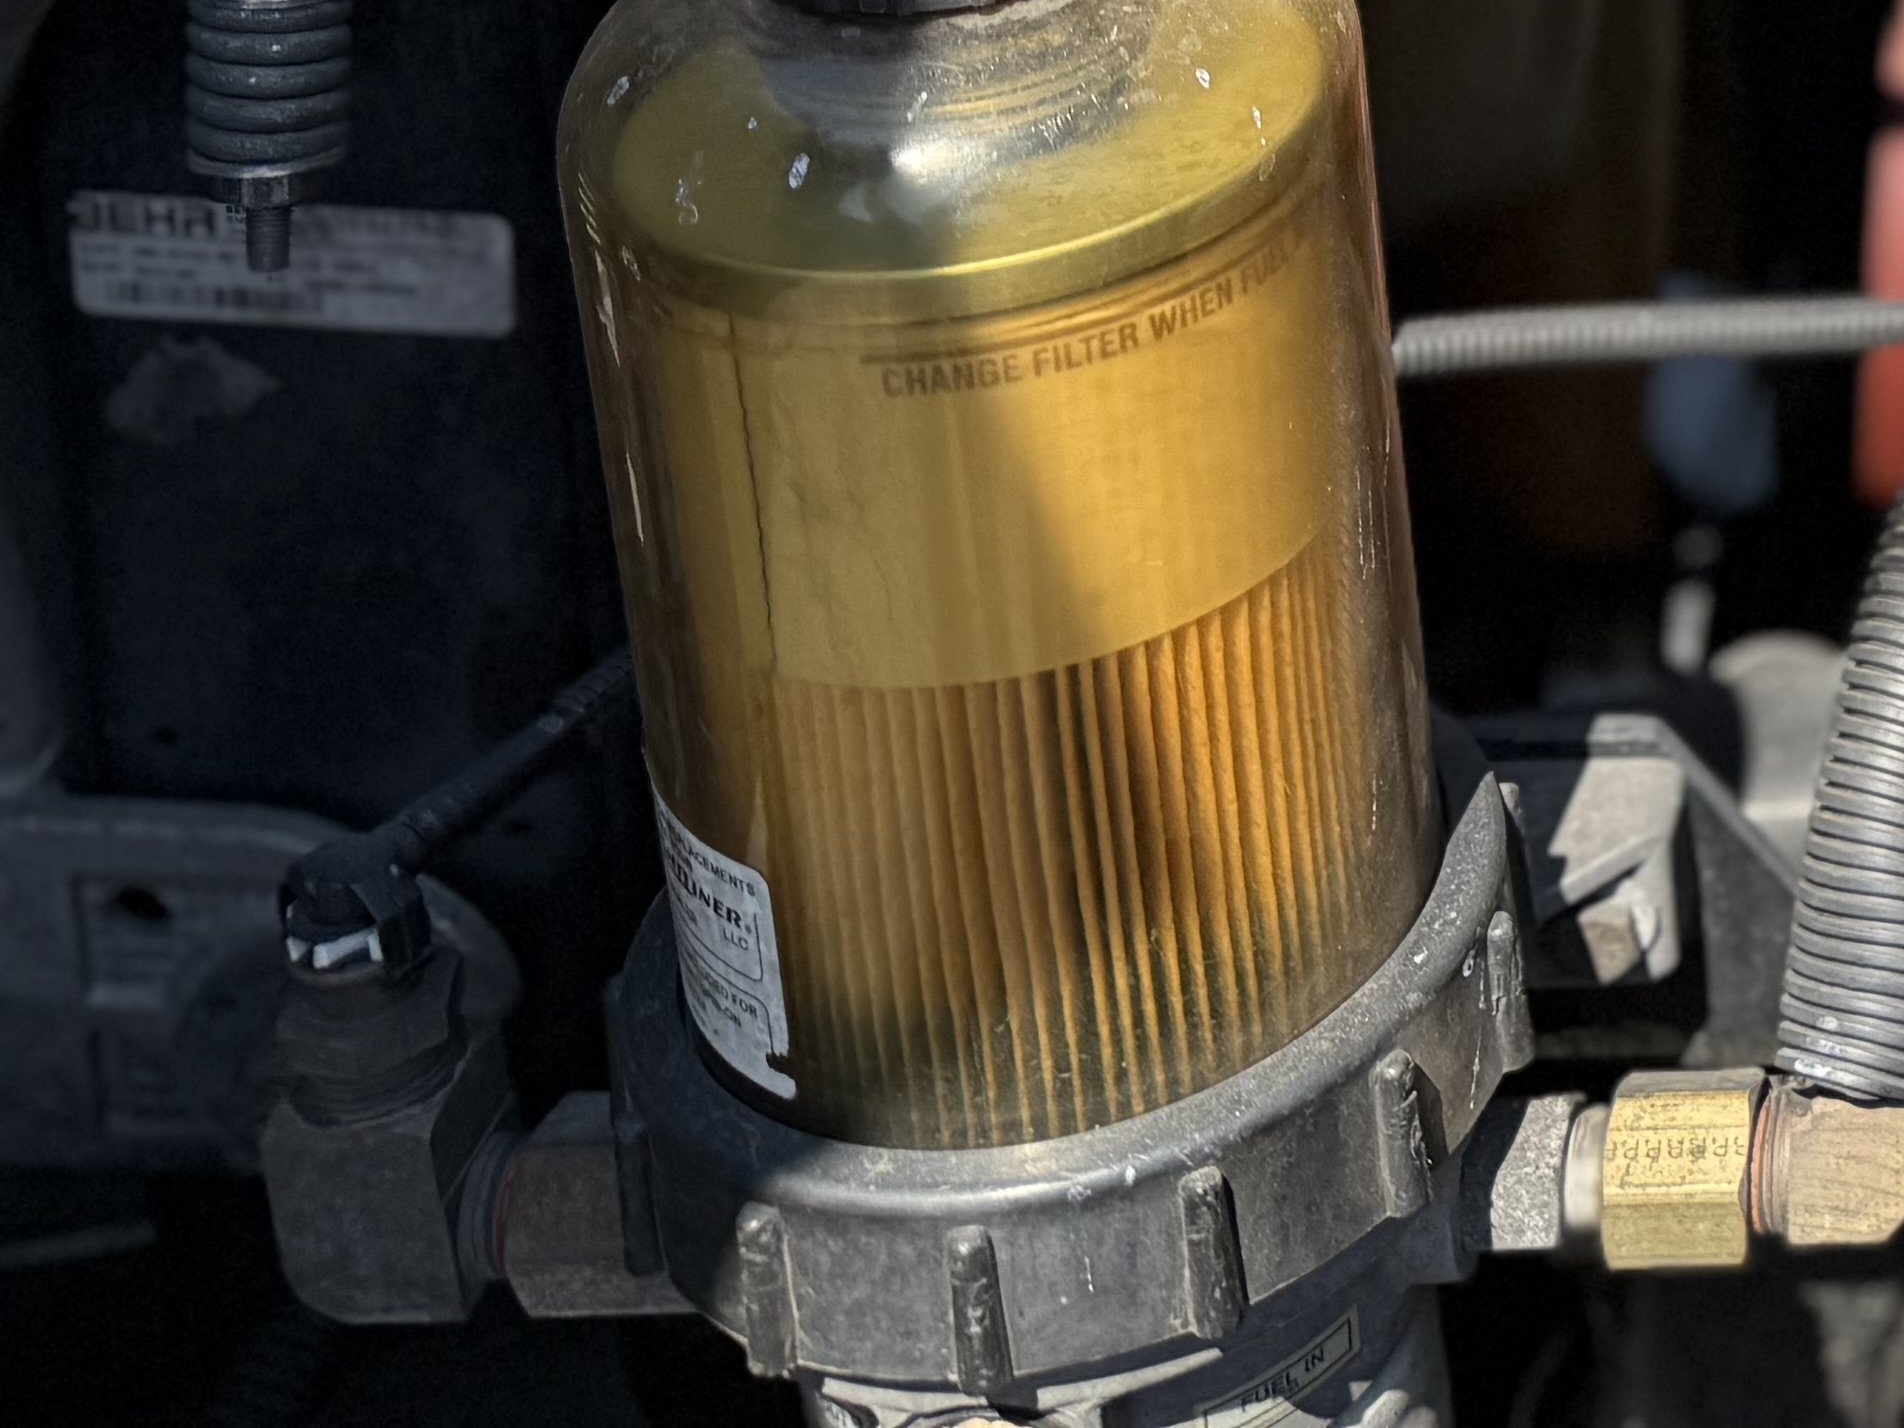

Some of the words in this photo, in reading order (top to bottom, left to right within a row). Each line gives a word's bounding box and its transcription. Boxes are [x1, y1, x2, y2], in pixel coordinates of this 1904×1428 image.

[882, 352, 1024, 398] CHANGE
[1032, 322, 1141, 378] FILTER
[1148, 278, 1234, 340] WHEN
[1304, 1346, 1325, 1373] IN
